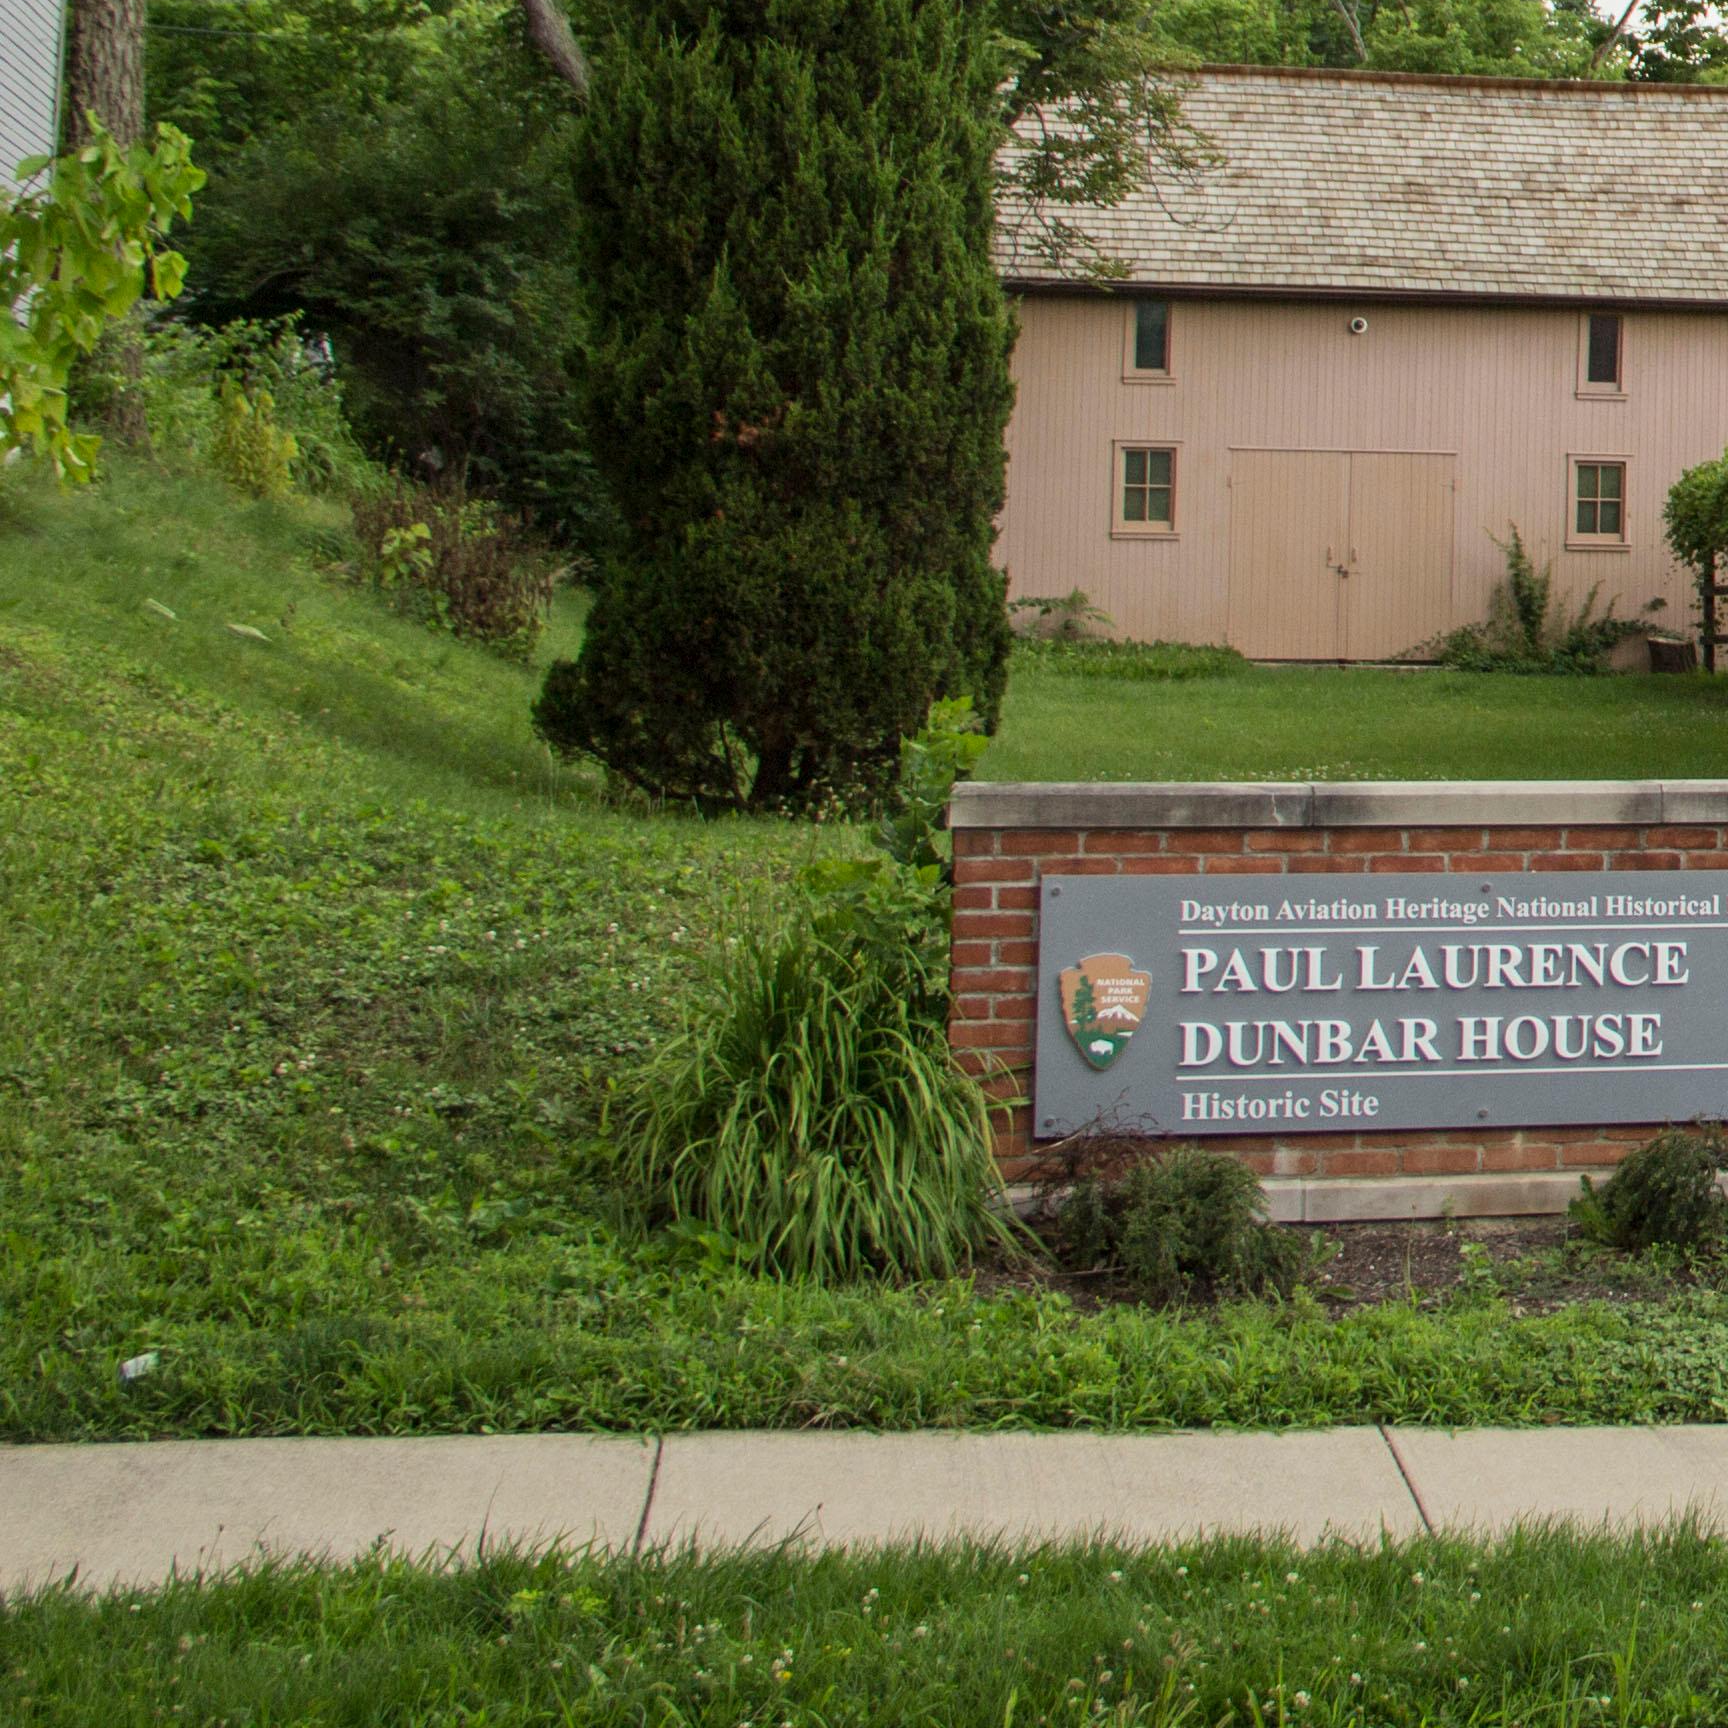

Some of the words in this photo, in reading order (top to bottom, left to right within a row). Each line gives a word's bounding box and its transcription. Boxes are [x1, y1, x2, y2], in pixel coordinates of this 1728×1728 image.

[1180, 900, 1269, 927] Dayton
[1275, 898, 1377, 920] Aviation
[1385, 897, 1490, 923] Heritage
[1496, 896, 1598, 918] National
[1605, 895, 1720, 917] Historical
[1180, 946, 1343, 993] PAUL
[1355, 941, 1690, 989] LAURENCE
[1178, 1018, 1443, 1067] DUNBAR
[1456, 1013, 1664, 1061] HOUSE
[1181, 1091, 1310, 1120] Historic
[1319, 1089, 1380, 1118] Site
